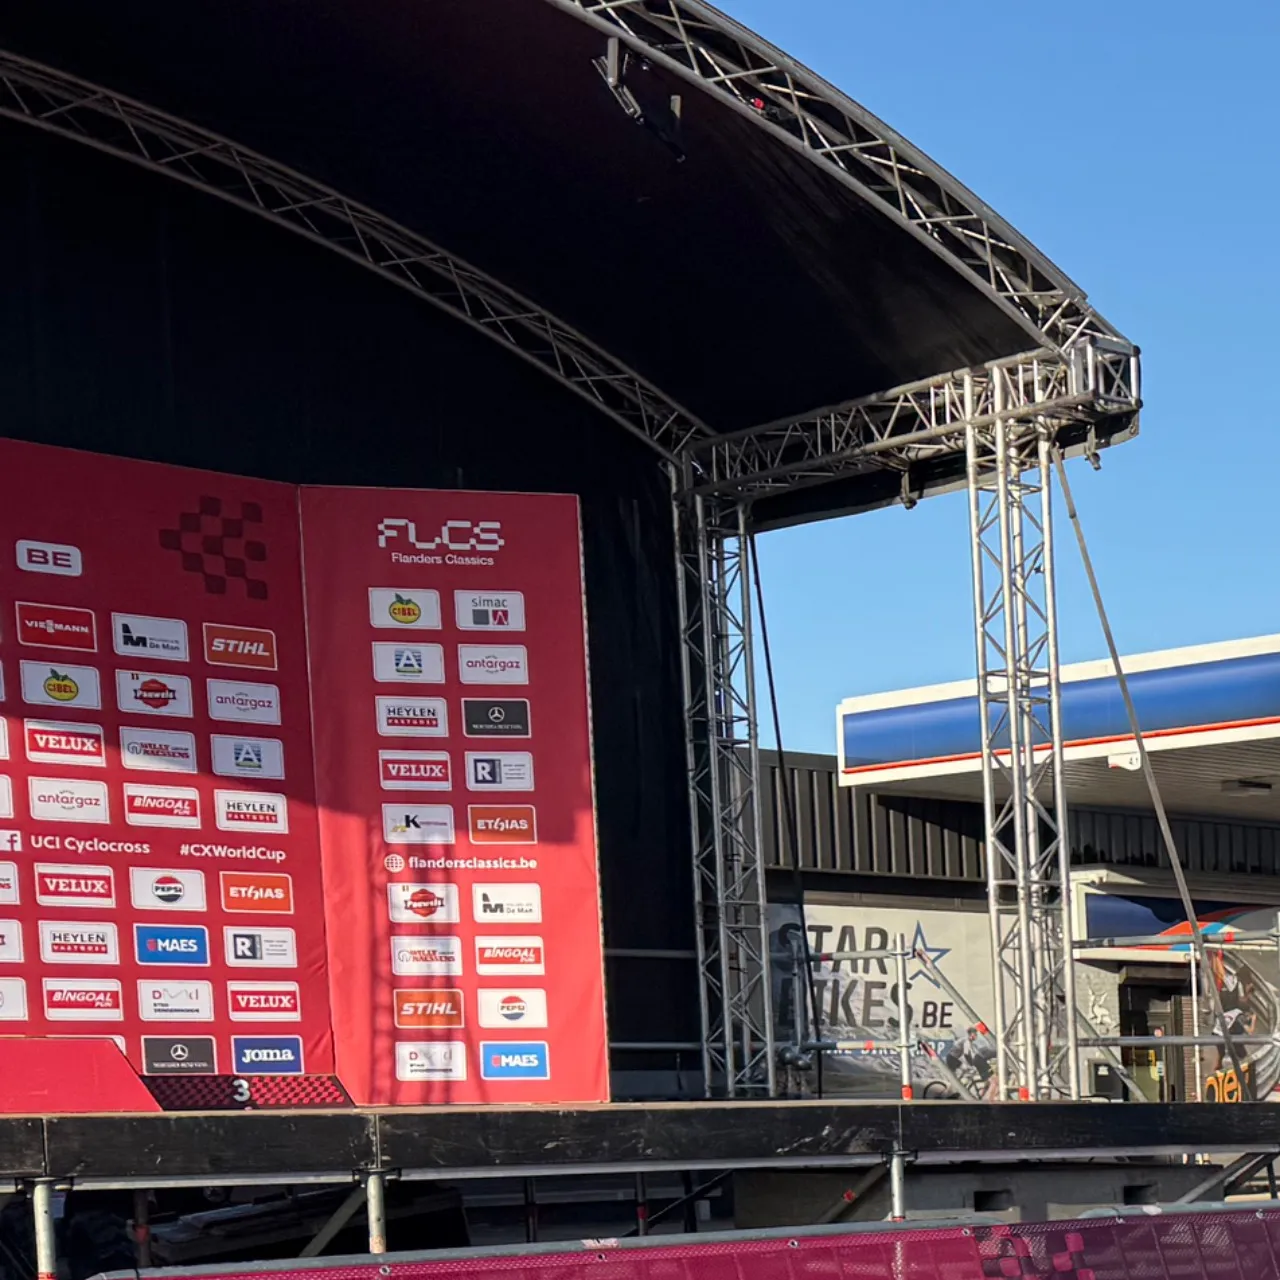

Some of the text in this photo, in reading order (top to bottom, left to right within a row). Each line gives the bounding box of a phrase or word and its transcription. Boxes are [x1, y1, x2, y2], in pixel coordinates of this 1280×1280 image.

[26, 547, 72, 568] BE
[391, 551, 494, 566] Flanders Classics
[471, 596, 508, 609] simac
[211, 638, 270, 656] STIHL
[466, 658, 521, 671] antargaz
[46, 682, 74, 694] CIBEL
[215, 694, 274, 711] antargaz
[387, 706, 437, 718] HEYLEN
[34, 733, 96, 752] VELUX
[387, 764, 444, 777] VELUX
[37, 794, 101, 809] antargaz
[226, 801, 276, 814] HEYLEN
[30, 835, 150, 854] UCI Cyclocross
[179, 843, 287, 864] #CXWorldCup
[409, 856, 538, 870] flandersclassics.be
[44, 878, 106, 893] VELUX
[52, 931, 106, 944] HEYLEN
[157, 939, 198, 953] MAES
[778, 922, 890, 975] STAR
[236, 994, 293, 1009] VELUX
[401, 1002, 457, 1015] STIHL
[501, 1055, 539, 1067] MAES
[232, 1078, 251, 1102] 3
